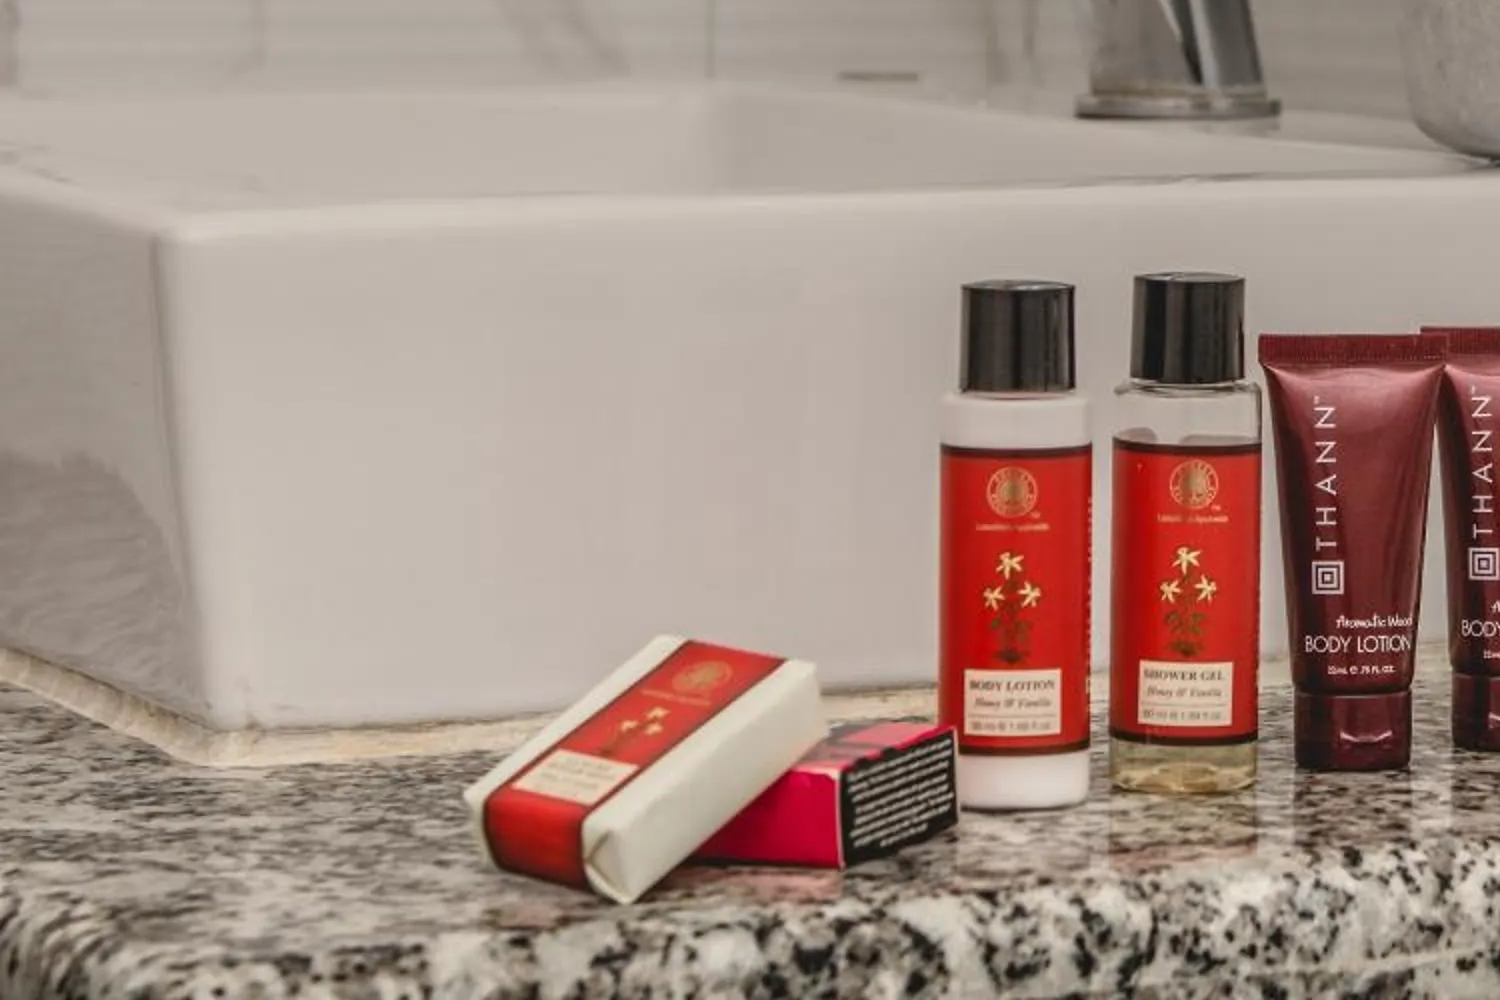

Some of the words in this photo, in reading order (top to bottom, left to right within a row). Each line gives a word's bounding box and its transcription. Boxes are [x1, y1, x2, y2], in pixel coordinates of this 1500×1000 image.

[1471, 394, 1494, 540] THANN
[1313, 405, 1338, 553] THANN
[1305, 635, 1352, 653] BODY
[1357, 634, 1411, 653] LOTION
[1143, 669, 1197, 681] SHOWER
[969, 680, 1002, 692] BODY
[1005, 680, 1055, 692] LOTION
